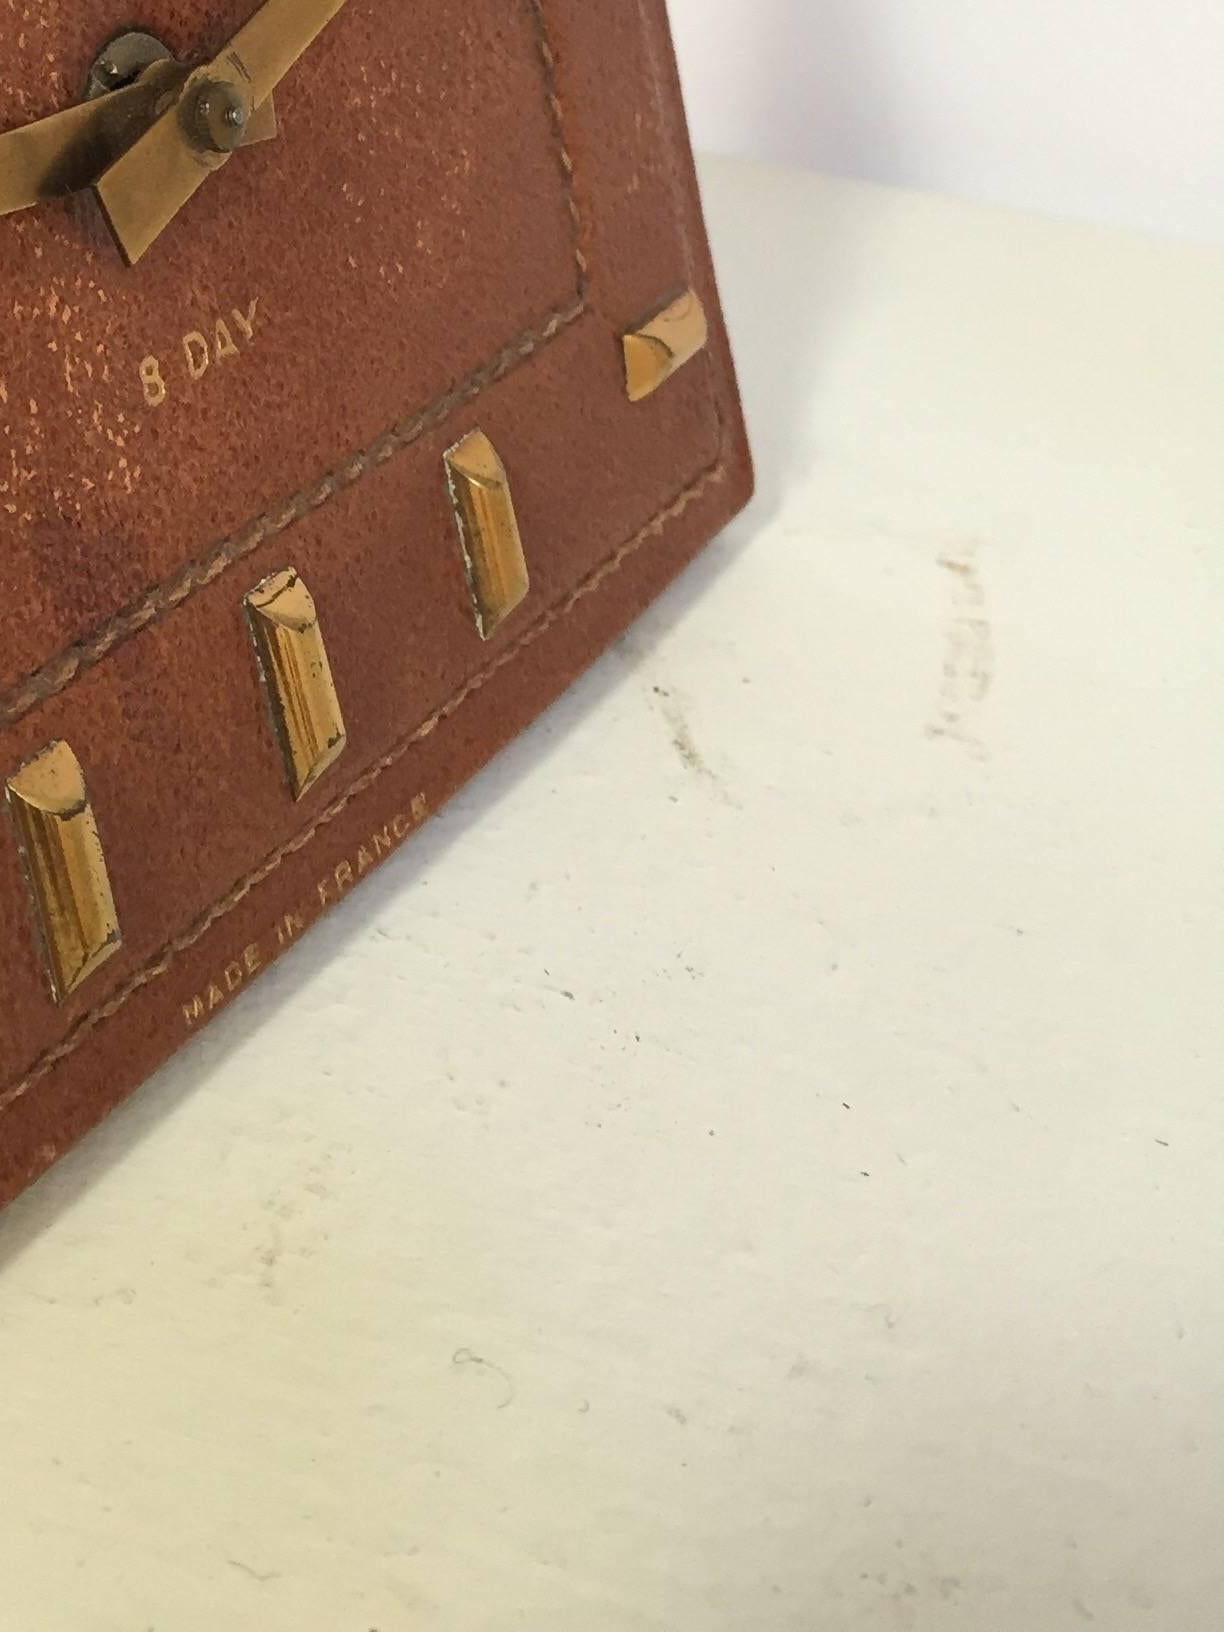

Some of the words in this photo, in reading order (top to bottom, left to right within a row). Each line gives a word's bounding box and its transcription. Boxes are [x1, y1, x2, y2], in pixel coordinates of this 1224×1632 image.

[139, 355, 166, 407] 8
[182, 296, 259, 380] DAY
[181, 942, 261, 1026] MADE
[276, 911, 304, 945] IN
[317, 791, 428, 905] FRANCE
